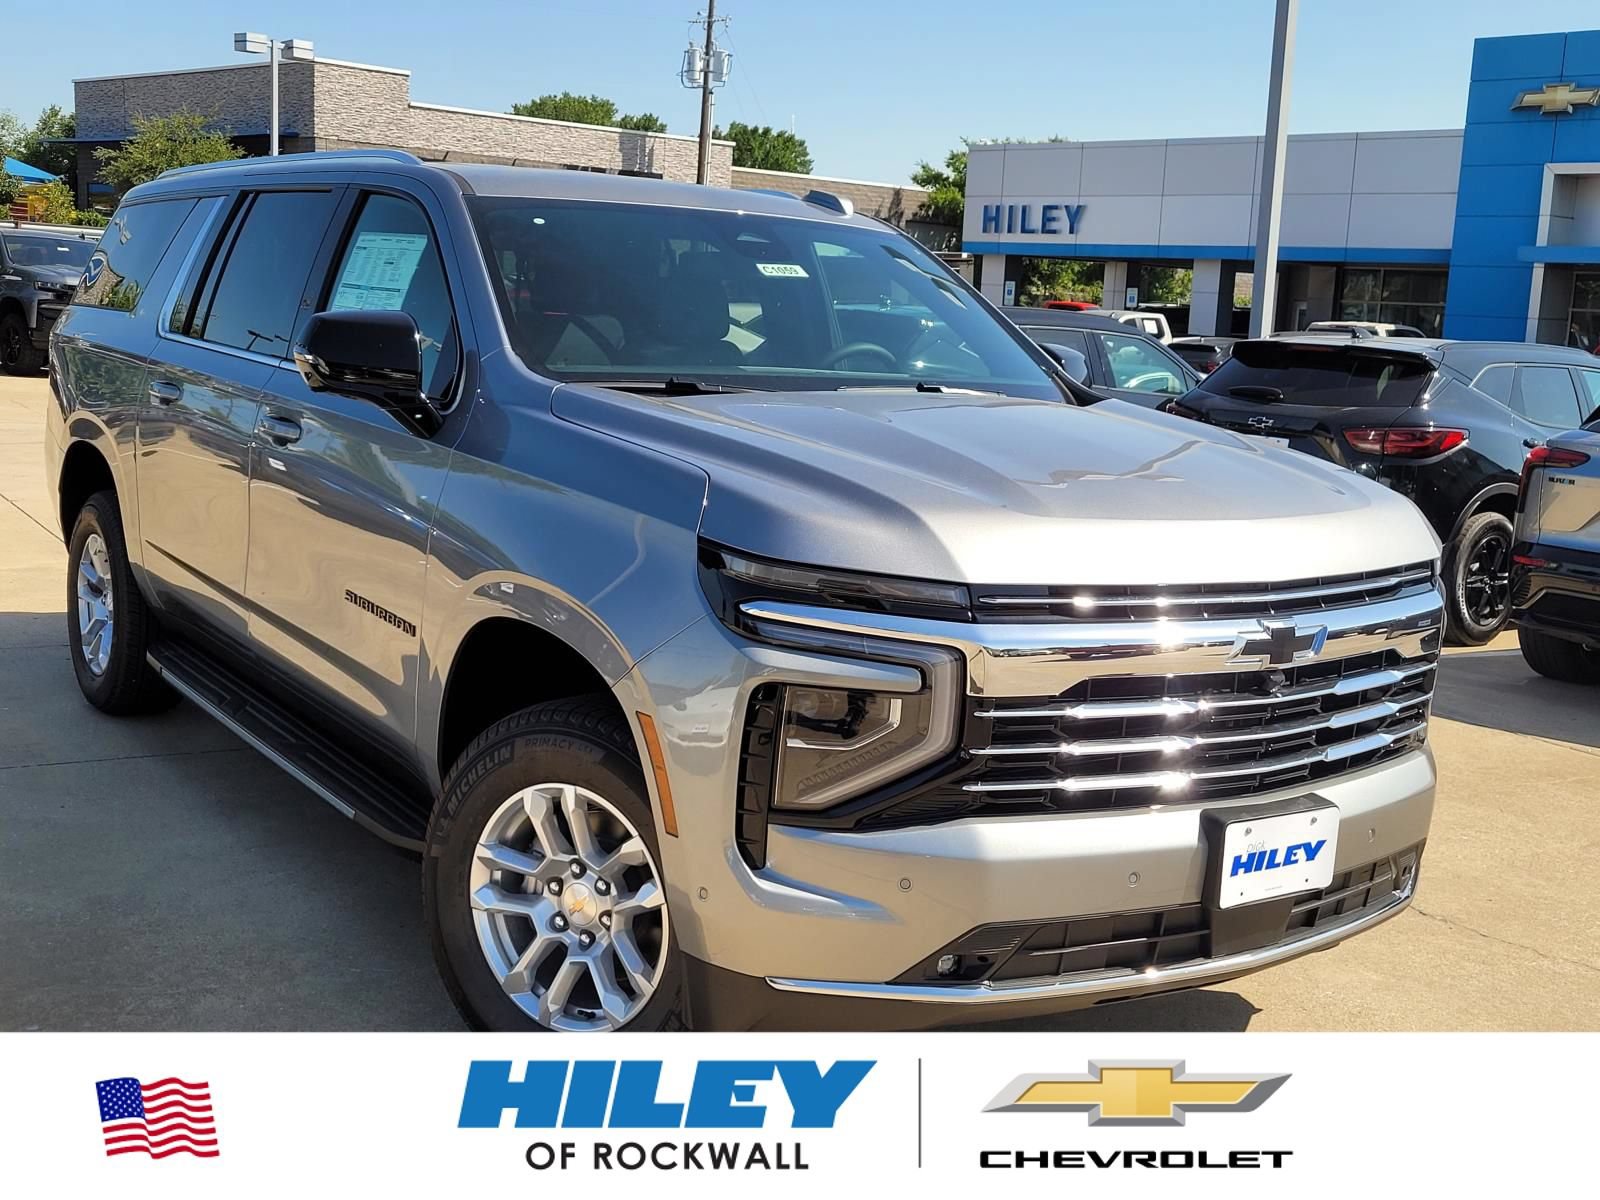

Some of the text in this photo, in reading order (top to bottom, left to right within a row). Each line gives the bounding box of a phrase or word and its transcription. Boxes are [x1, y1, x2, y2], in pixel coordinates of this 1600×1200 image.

[982, 204, 1086, 235] HILEY
[344, 589, 417, 637] SUBURBAN
[447, 743, 512, 816] MICHELIN
[1230, 840, 1327, 878] HILEY
